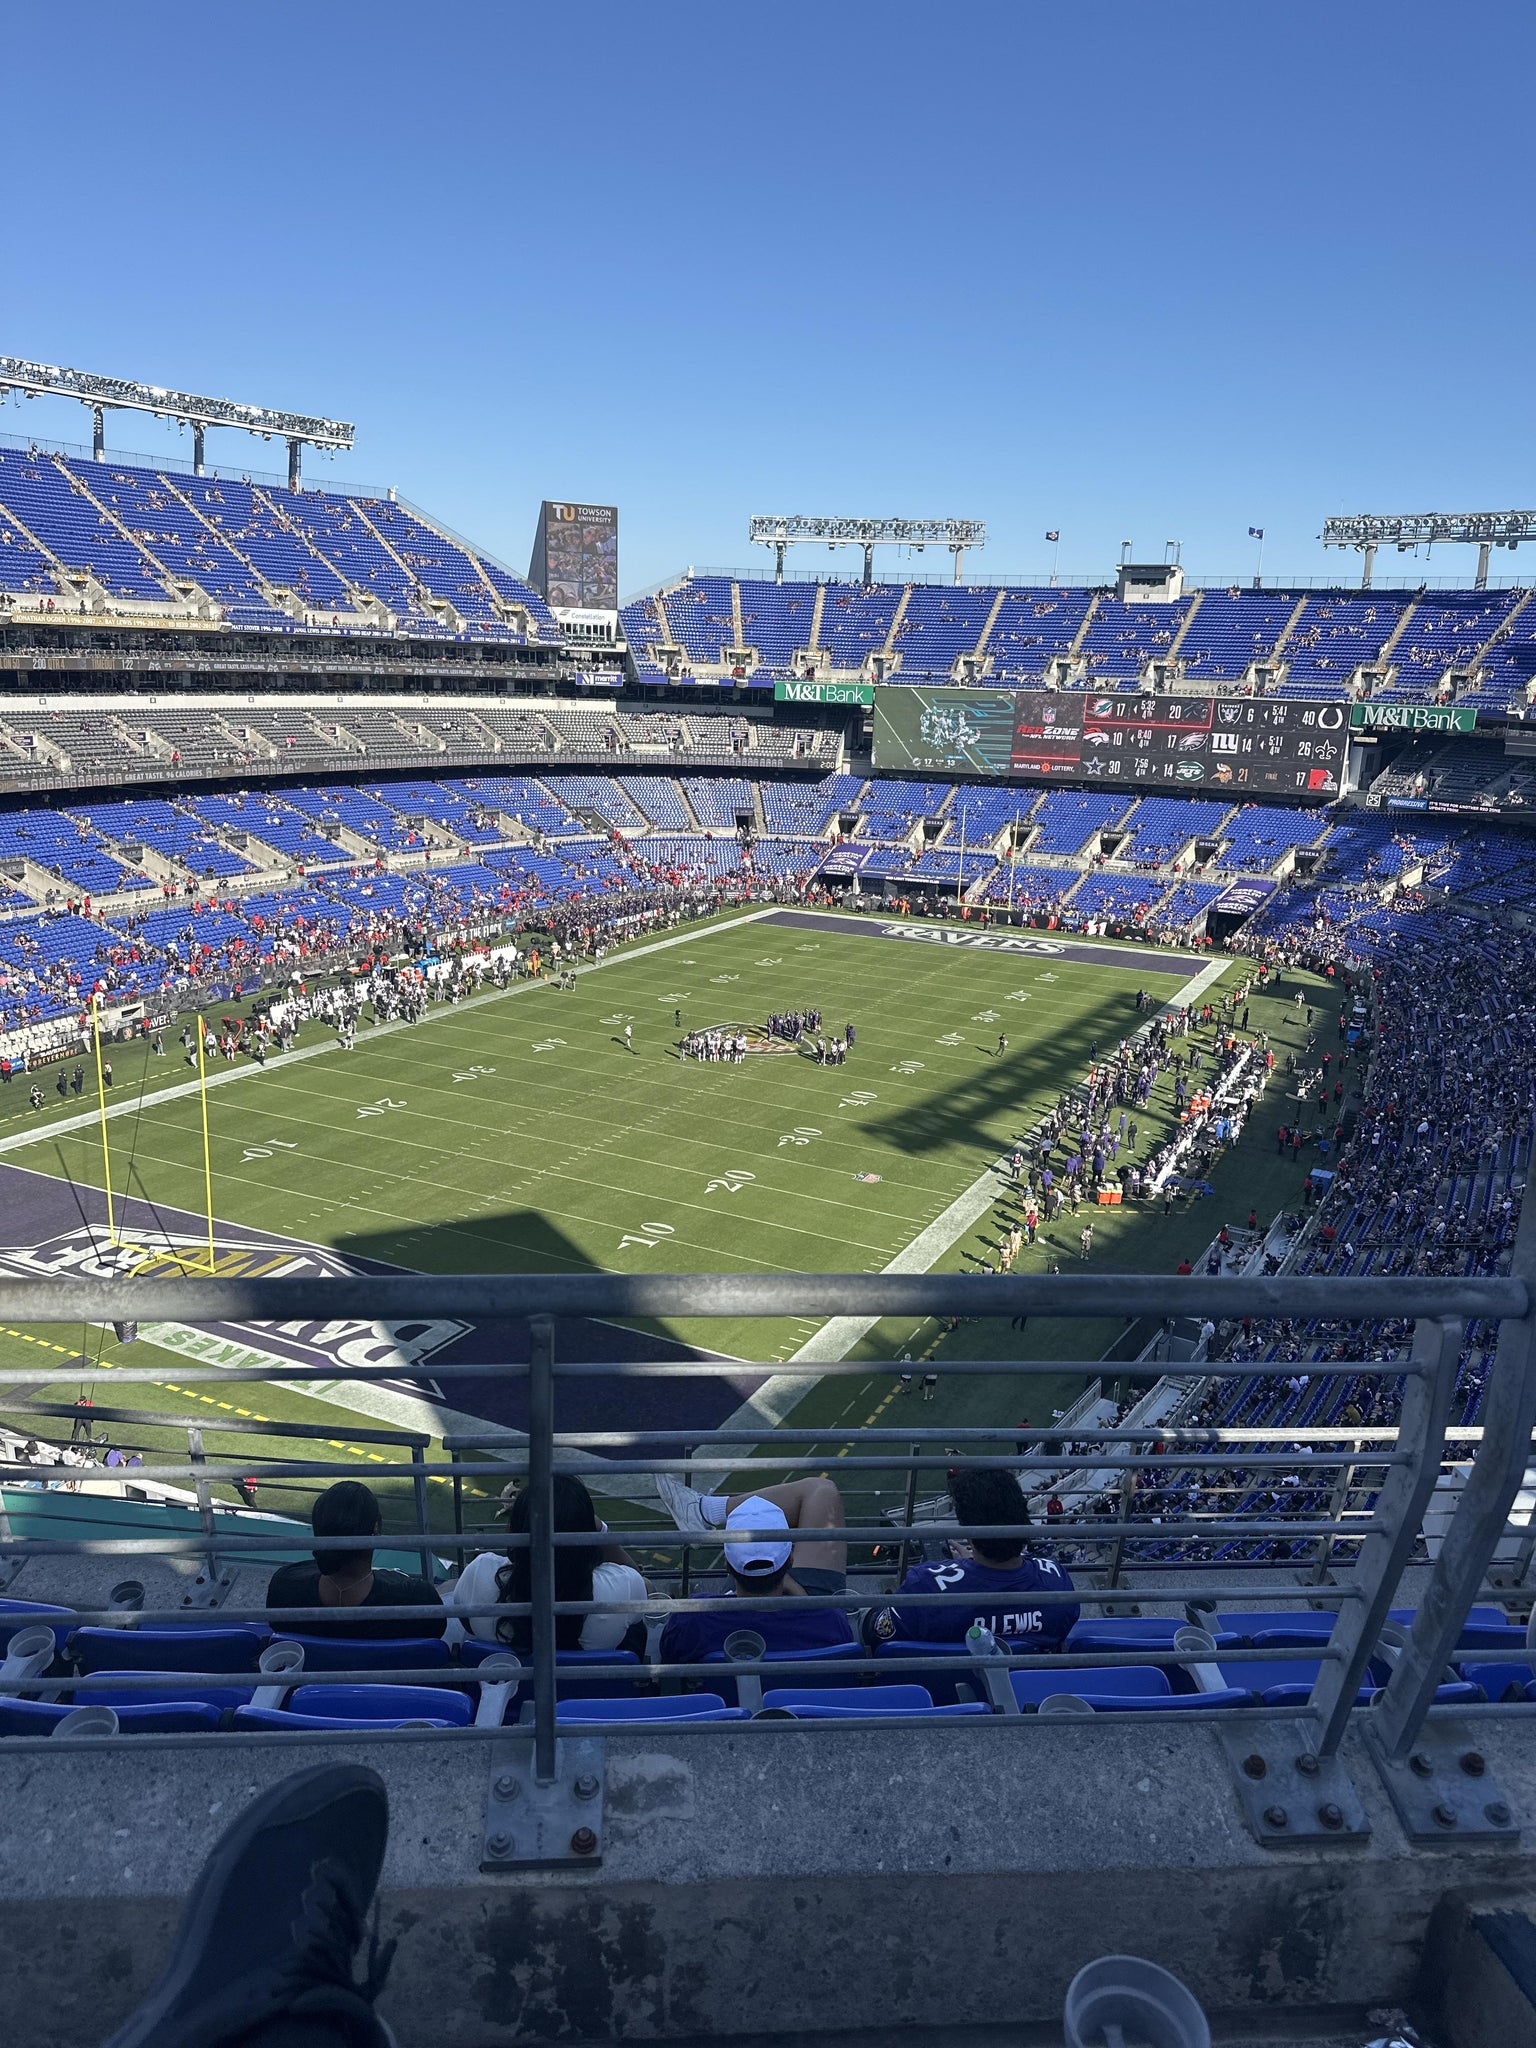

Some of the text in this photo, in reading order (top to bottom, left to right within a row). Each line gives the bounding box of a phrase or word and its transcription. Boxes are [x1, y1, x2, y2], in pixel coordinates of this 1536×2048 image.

[553, 504, 575, 522] TU
[578, 508, 611, 516] TOWSON
[16, 614, 45, 622] JONATHAN
[33, 658, 46, 669] 2:00
[784, 684, 864, 703] M&T Bank
[1117, 703, 1125, 716] 17
[1141, 701, 1155, 710] 5:32
[1272, 706, 1287, 716] 5:41
[1142, 710, 1153, 719] 4TH
[1169, 706, 1181, 719] 20
[1248, 708, 1254, 723] 6
[1302, 711, 1315, 725] 40
[1363, 706, 1461, 730] M&T Bank
[1273, 716, 1284, 726] 4TH
[1113, 732, 1122, 745] 10
[1168, 735, 1176, 748] 17
[1269, 736, 1283, 746] 5:11
[1242, 739, 1252, 752] 14
[1270, 747, 1280, 756] 4TH
[1298, 742, 1311, 756] 26
[821, 761, 834, 769] 2:00
[1109, 761, 1120, 774] 30
[1135, 758, 1148, 768] 7:56
[125, 770, 203, 781] GREAT TASTE. 96 CALORIES.
[1164, 764, 1173, 777] 14
[1238, 769, 1248, 782] 21
[1296, 772, 1306, 786] 17
[1388, 799, 1425, 808] PROGRESSIVE
[470, 926, 481, 940] THE
[884, 925, 1065, 953] RAVENS
[600, 1014, 635, 1024] 50
[971, 1011, 1001, 1022] 30
[531, 1038, 567, 1050] 40
[935, 1034, 965, 1046] 40
[452, 1066, 496, 1080] 30
[889, 1060, 925, 1074] 50
[846, 1091, 877, 1106] 40
[357, 1098, 407, 1115] 20
[779, 1127, 822, 1146] 30
[243, 1138, 298, 1158] 10
[708, 1170, 756, 1192] 20
[622, 1222, 675, 1248] 10
